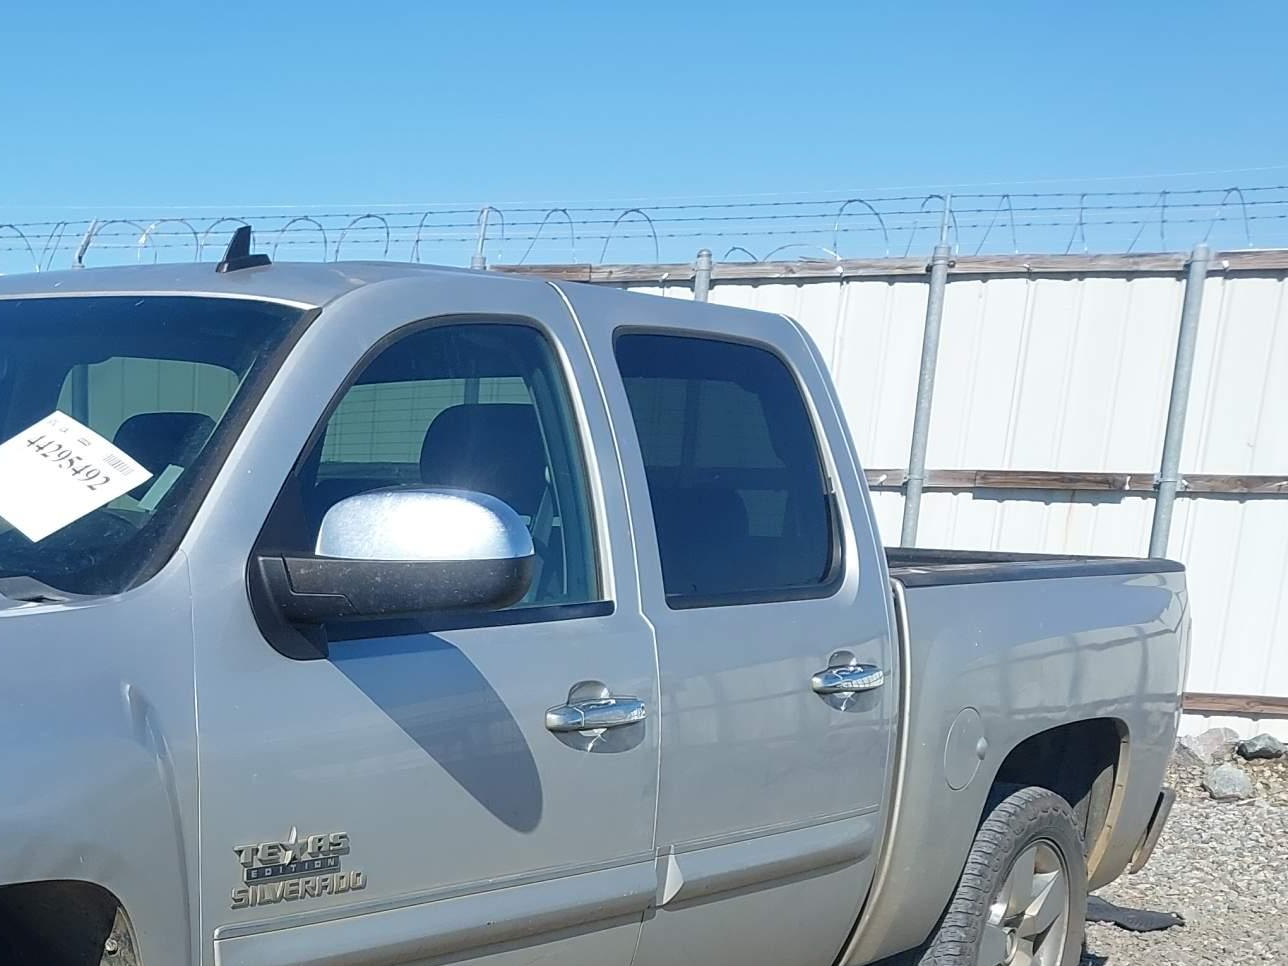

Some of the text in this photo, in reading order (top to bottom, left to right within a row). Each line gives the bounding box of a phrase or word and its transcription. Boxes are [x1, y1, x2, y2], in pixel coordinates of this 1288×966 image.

[27, 434, 111, 491] 44295492
[233, 830, 350, 867] TEXAS
[250, 859, 336, 879] EDITION
[231, 871, 367, 910] SILVERADO
